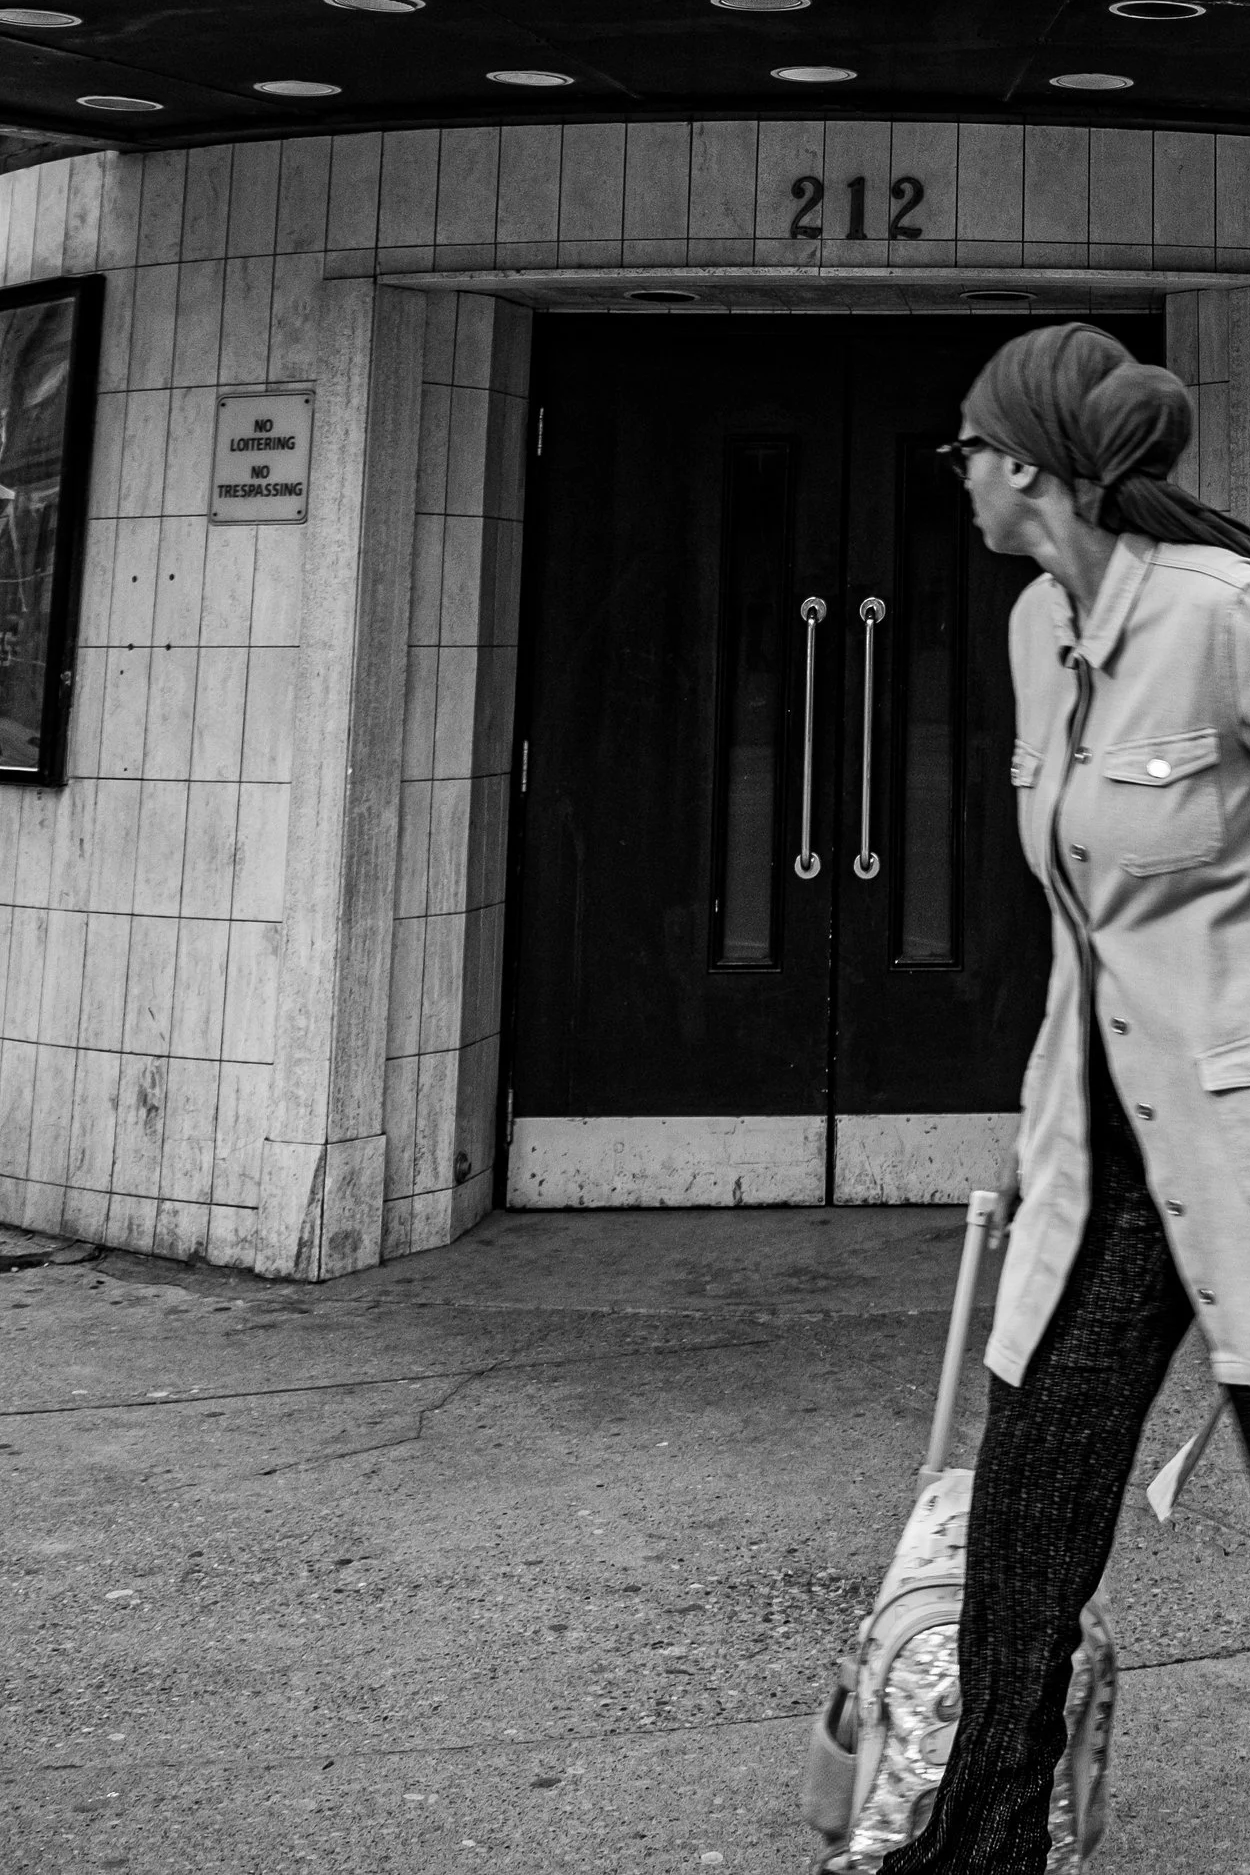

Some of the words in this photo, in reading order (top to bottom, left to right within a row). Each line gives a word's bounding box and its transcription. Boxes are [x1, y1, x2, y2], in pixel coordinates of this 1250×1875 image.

[790, 176, 924, 239] 212
[254, 418, 274, 433] NO
[230, 436, 296, 452] LOITERING
[250, 465, 270, 480] NO
[217, 482, 303, 498] TRESPASSING
